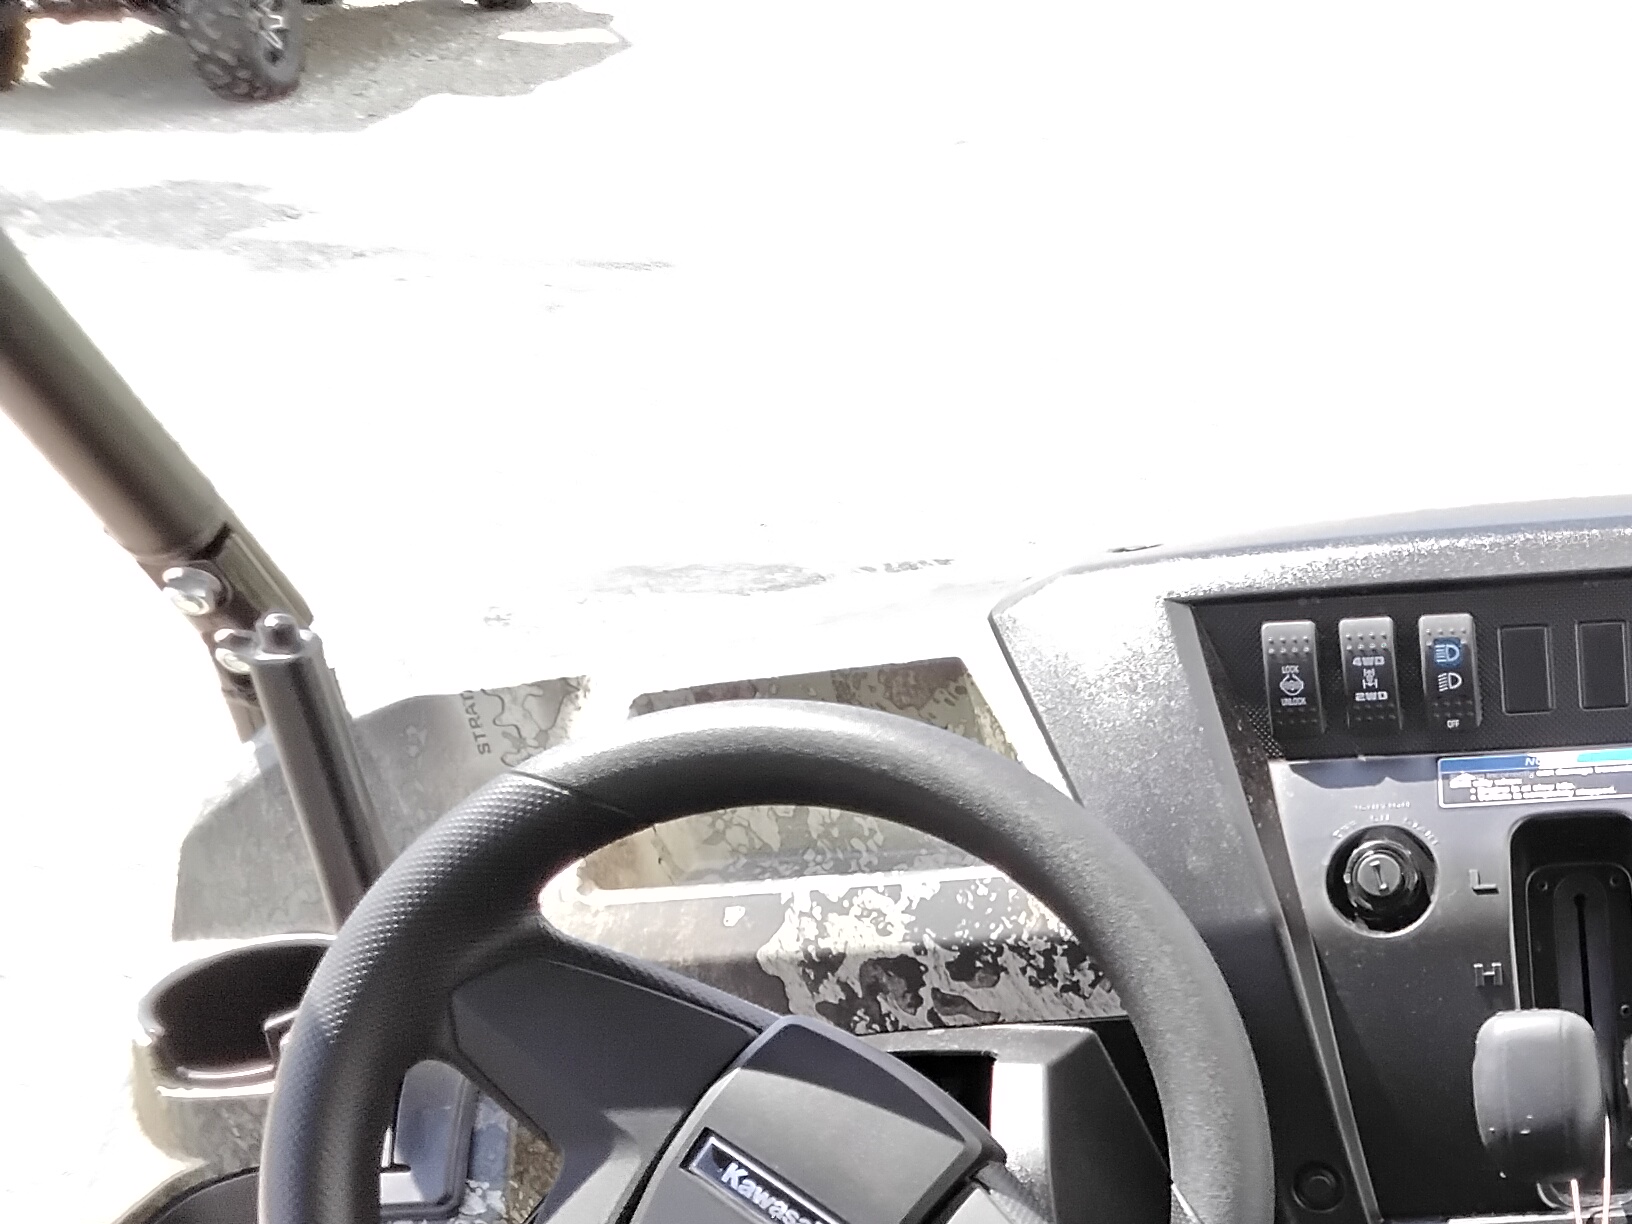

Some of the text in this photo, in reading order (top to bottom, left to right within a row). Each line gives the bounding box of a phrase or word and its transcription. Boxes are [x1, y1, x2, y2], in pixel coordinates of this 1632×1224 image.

[1353, 656, 1385, 665] 4WD
[1282, 666, 1299, 674] LOCK
[1355, 691, 1388, 701] 2WD
[1281, 698, 1306, 706] UNLOCK
[459, 690, 491, 755] STRAT
[1447, 720, 1459, 728] OFF
[1468, 869, 1499, 895] L
[1473, 962, 1503, 987] H
